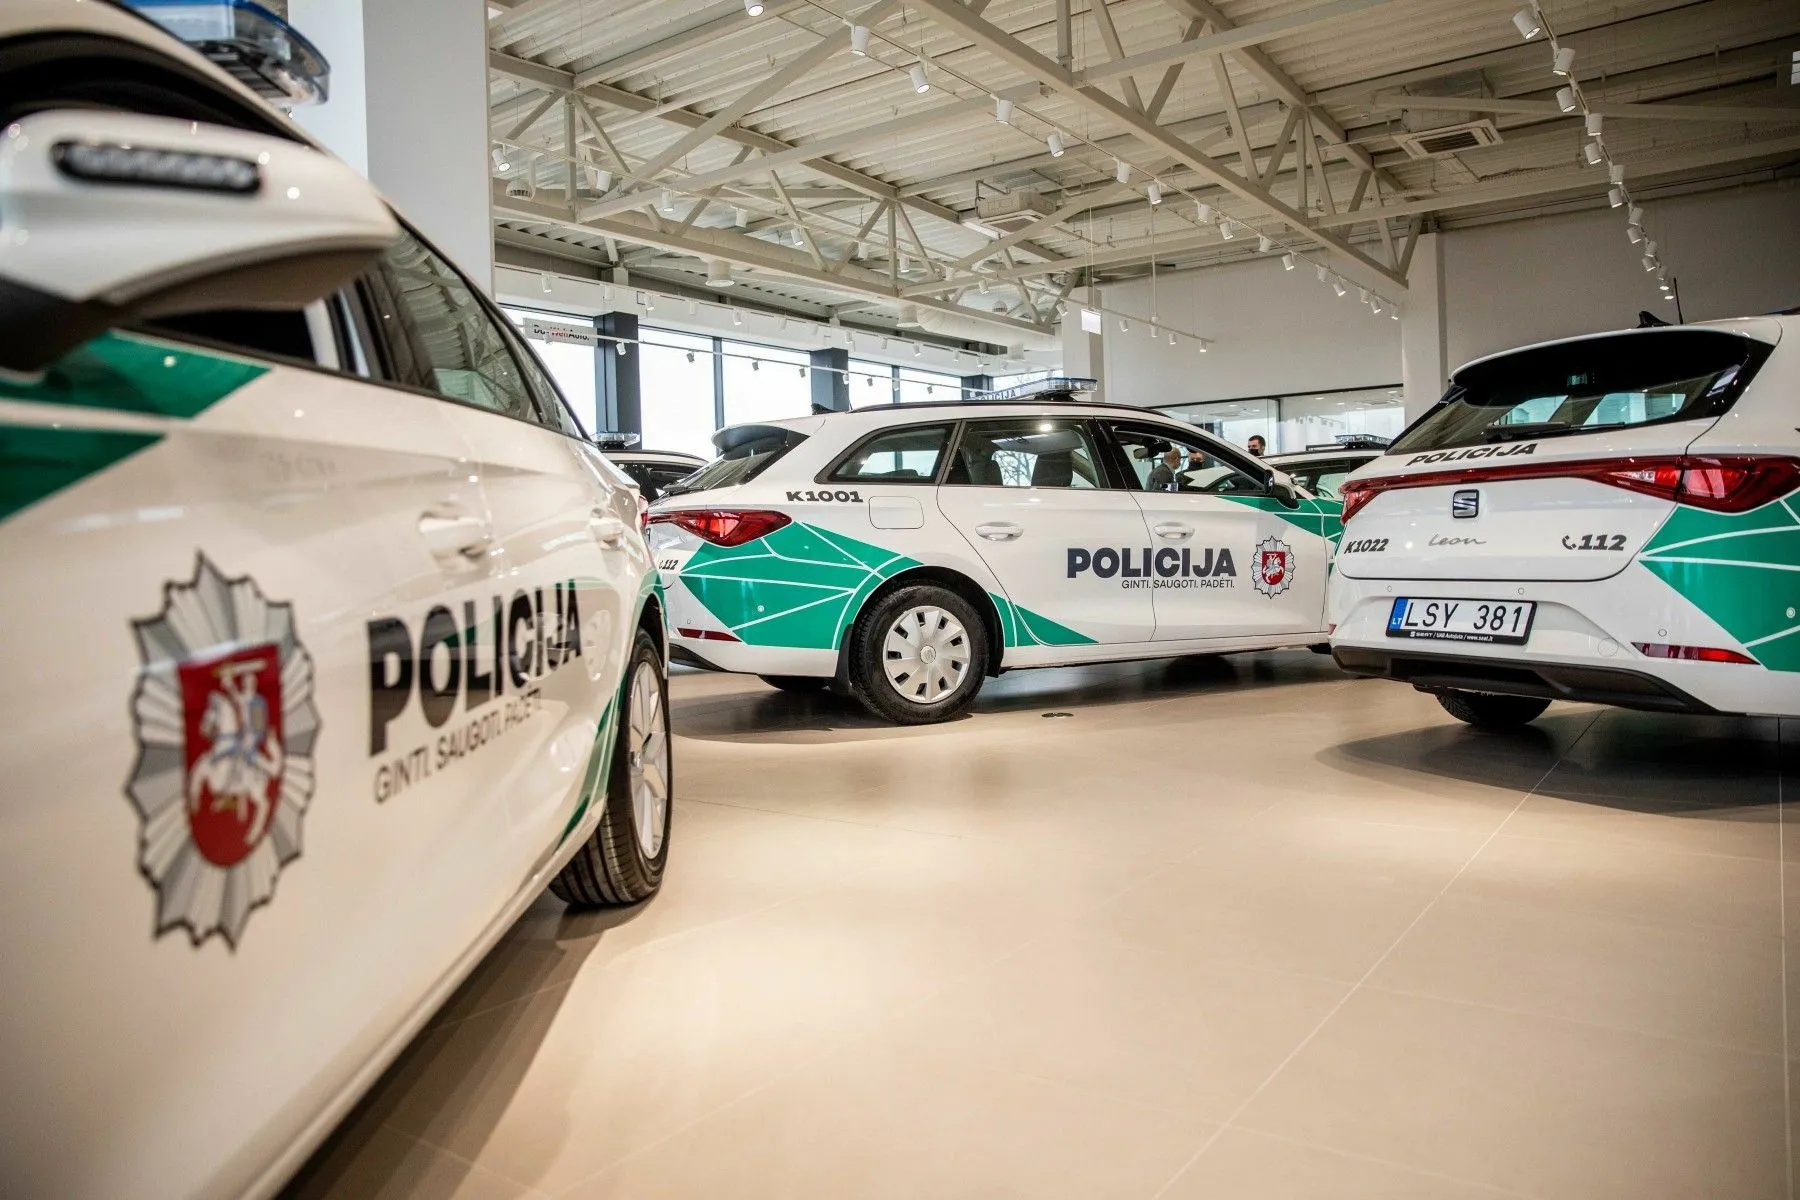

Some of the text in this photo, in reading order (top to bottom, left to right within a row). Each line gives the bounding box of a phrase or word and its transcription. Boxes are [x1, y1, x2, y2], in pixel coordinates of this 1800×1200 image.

[979, 389, 1016, 401] OLICIJA
[1405, 443, 1538, 467] POLICIJA
[785, 490, 864, 503] K1001
[1344, 538, 1390, 555] K1022
[1578, 534, 1627, 551] 112
[661, 559, 679, 570] 112
[1067, 547, 1237, 579] POLICIJA
[1121, 577, 1235, 589] GINTI. SAUGOTI. PADĖTI.
[1391, 617, 1403, 625] LT
[1404, 602, 1523, 633] LSY 381
[366, 578, 582, 759] POLICIJA
